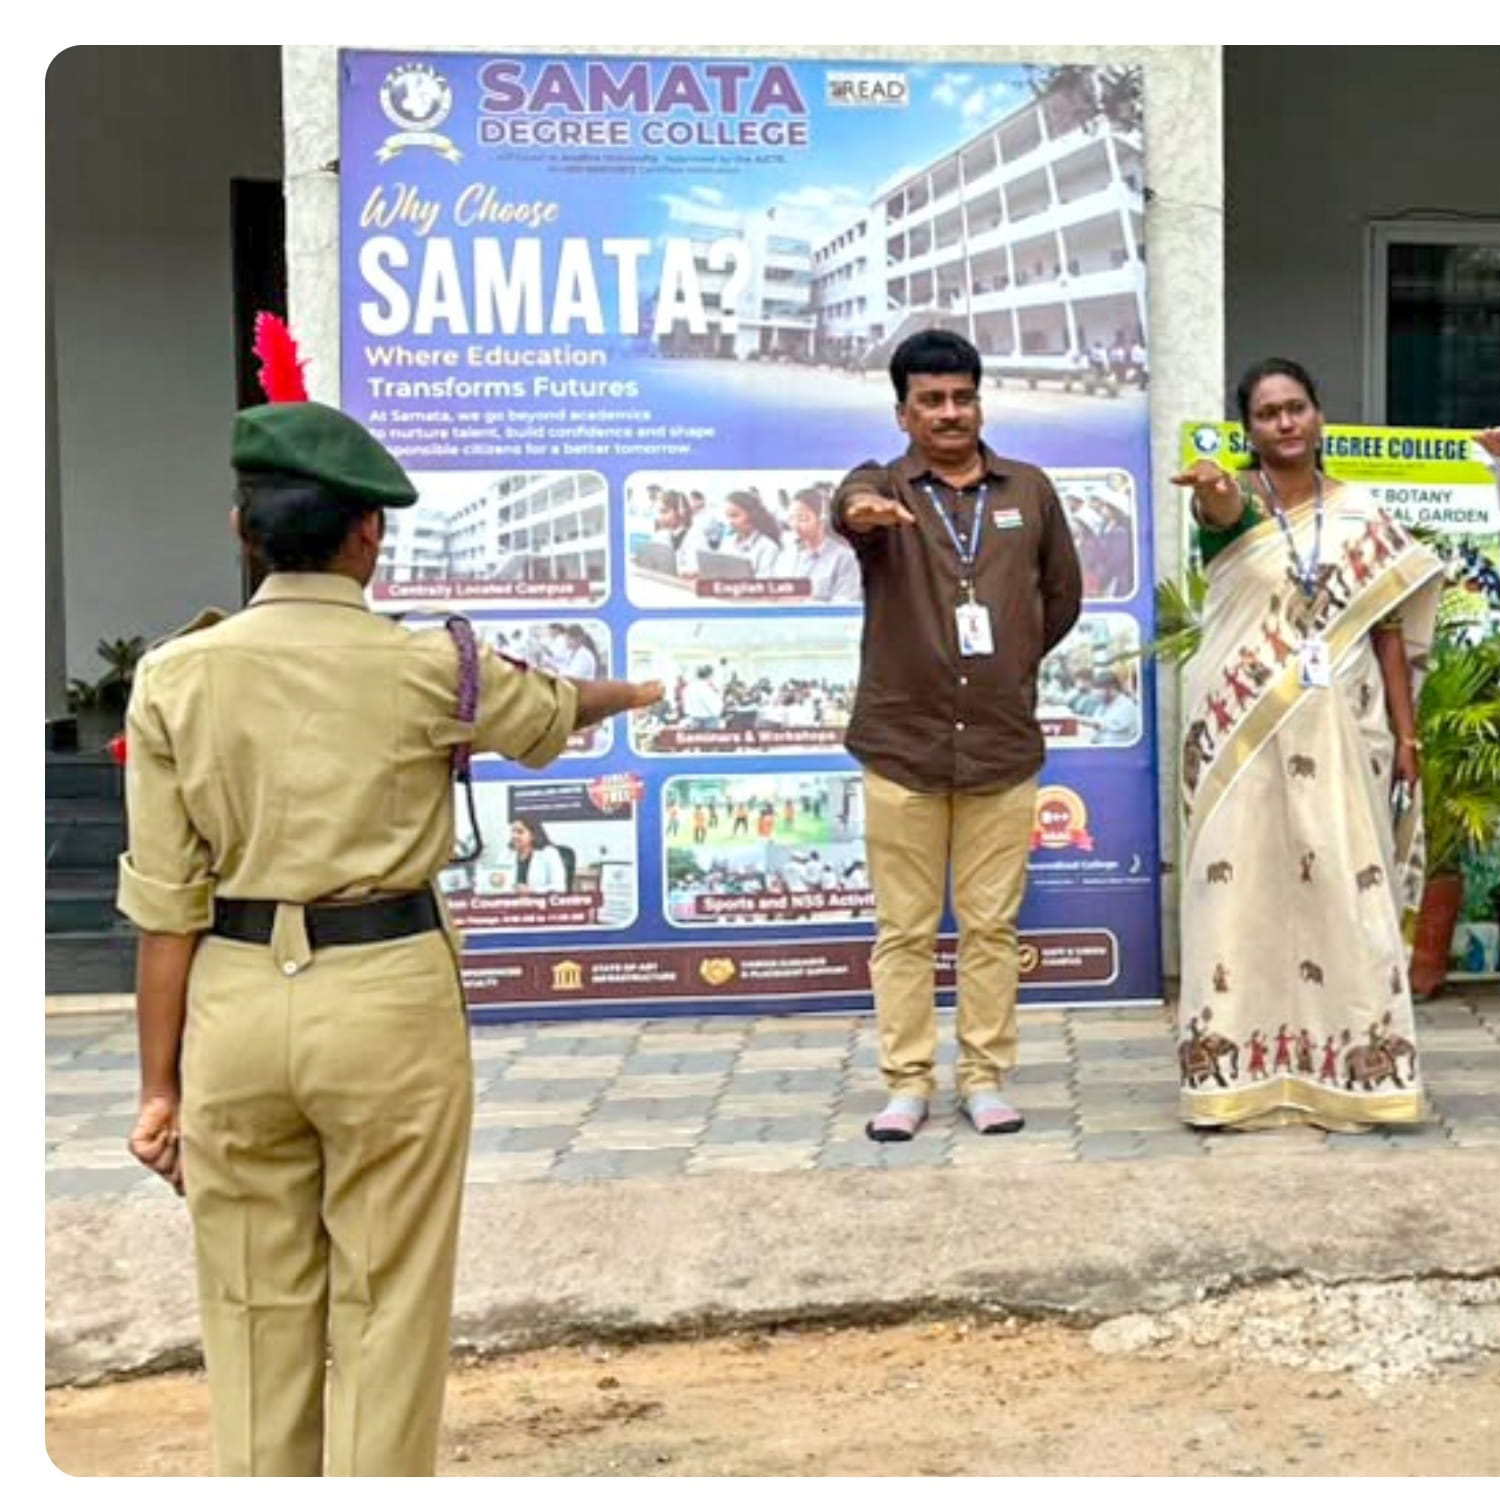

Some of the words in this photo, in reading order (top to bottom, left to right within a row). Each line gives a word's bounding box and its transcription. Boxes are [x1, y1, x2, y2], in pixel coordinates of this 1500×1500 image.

[482, 62, 808, 116] SAMATA
[842, 80, 905, 98] READ
[480, 120, 629, 147] DEGREE
[641, 121, 807, 147] COLLEGE
[360, 183, 440, 236] Why
[454, 182, 559, 228] Choose
[359, 234, 751, 337] SAMATA?
[366, 346, 458, 367] Where
[468, 345, 606, 367] Education
[368, 376, 525, 398] Transforms
[534, 376, 639, 398] Futures
[370, 410, 386, 422] At
[391, 409, 455, 424] Samata,
[458, 411, 480, 422] we
[485, 411, 504, 424] go
[508, 409, 565, 425] beyond
[570, 409, 651, 422] academics
[389, 427, 448, 439] nurture
[452, 426, 501, 440] talent,
[506, 426, 544, 438] build
[548, 426, 632, 438] confidence
[638, 426, 666, 438] and
[670, 426, 715, 441] shape
[463, 444, 521, 456] citizens
[525, 443, 547, 455] for
[552, 446, 560, 455] a
[563, 443, 609, 455] better
[614, 444, 691, 455] tomorrow
[1326, 435, 1383, 458] EGREE
[1388, 437, 1467, 460] COLLEGE
[1386, 490, 1452, 503] BOTANY
[1418, 509, 1488, 523] GARDEN
[388, 583, 451, 598] Centrally
[456, 583, 512, 596] Located
[516, 582, 574, 597] Campus
[713, 581, 765, 597] English
[768, 580, 794, 594] Lab
[676, 731, 741, 744] Seminars
[745, 730, 755, 743] &
[759, 729, 836, 743] Workshops
[705, 897, 754, 912] Sports
[758, 896, 787, 909] and
[791, 894, 825, 908] NSS
[829, 893, 875, 907] Activit
